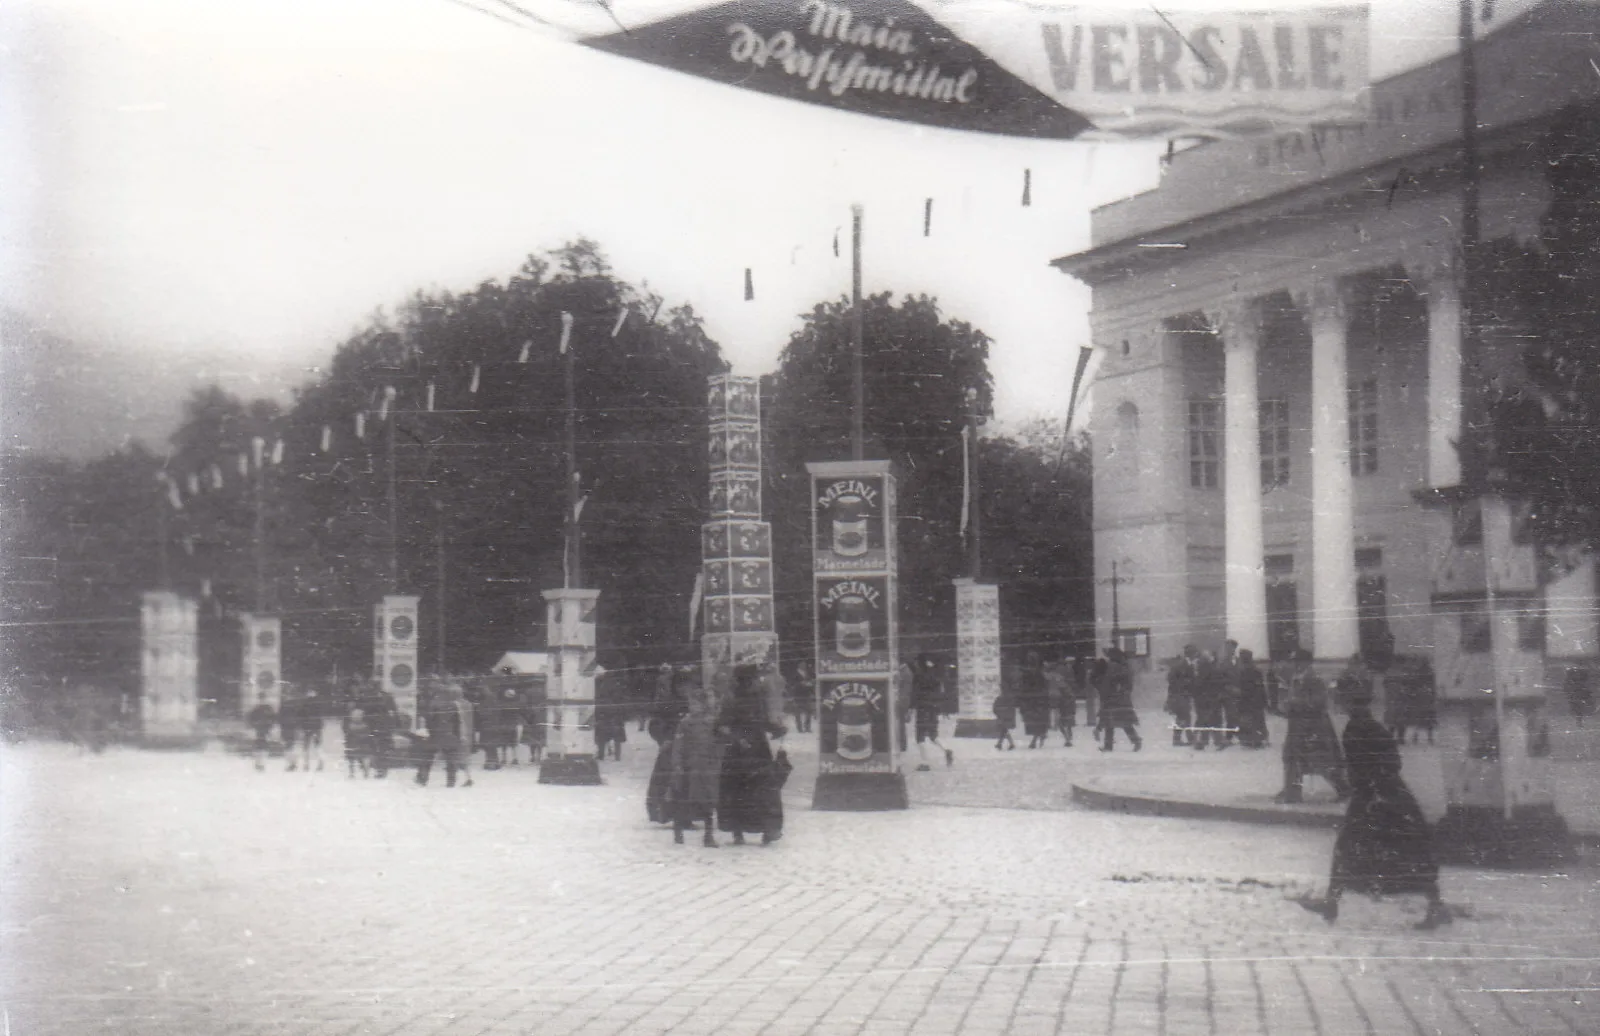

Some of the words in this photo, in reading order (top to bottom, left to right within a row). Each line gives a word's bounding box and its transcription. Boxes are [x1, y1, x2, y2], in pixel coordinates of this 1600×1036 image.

[1041, 22, 1346, 93] VERSALE
[818, 480, 878, 508] MEINL
[821, 581, 880, 609] MEINL
[823, 682, 882, 711] MEINL
